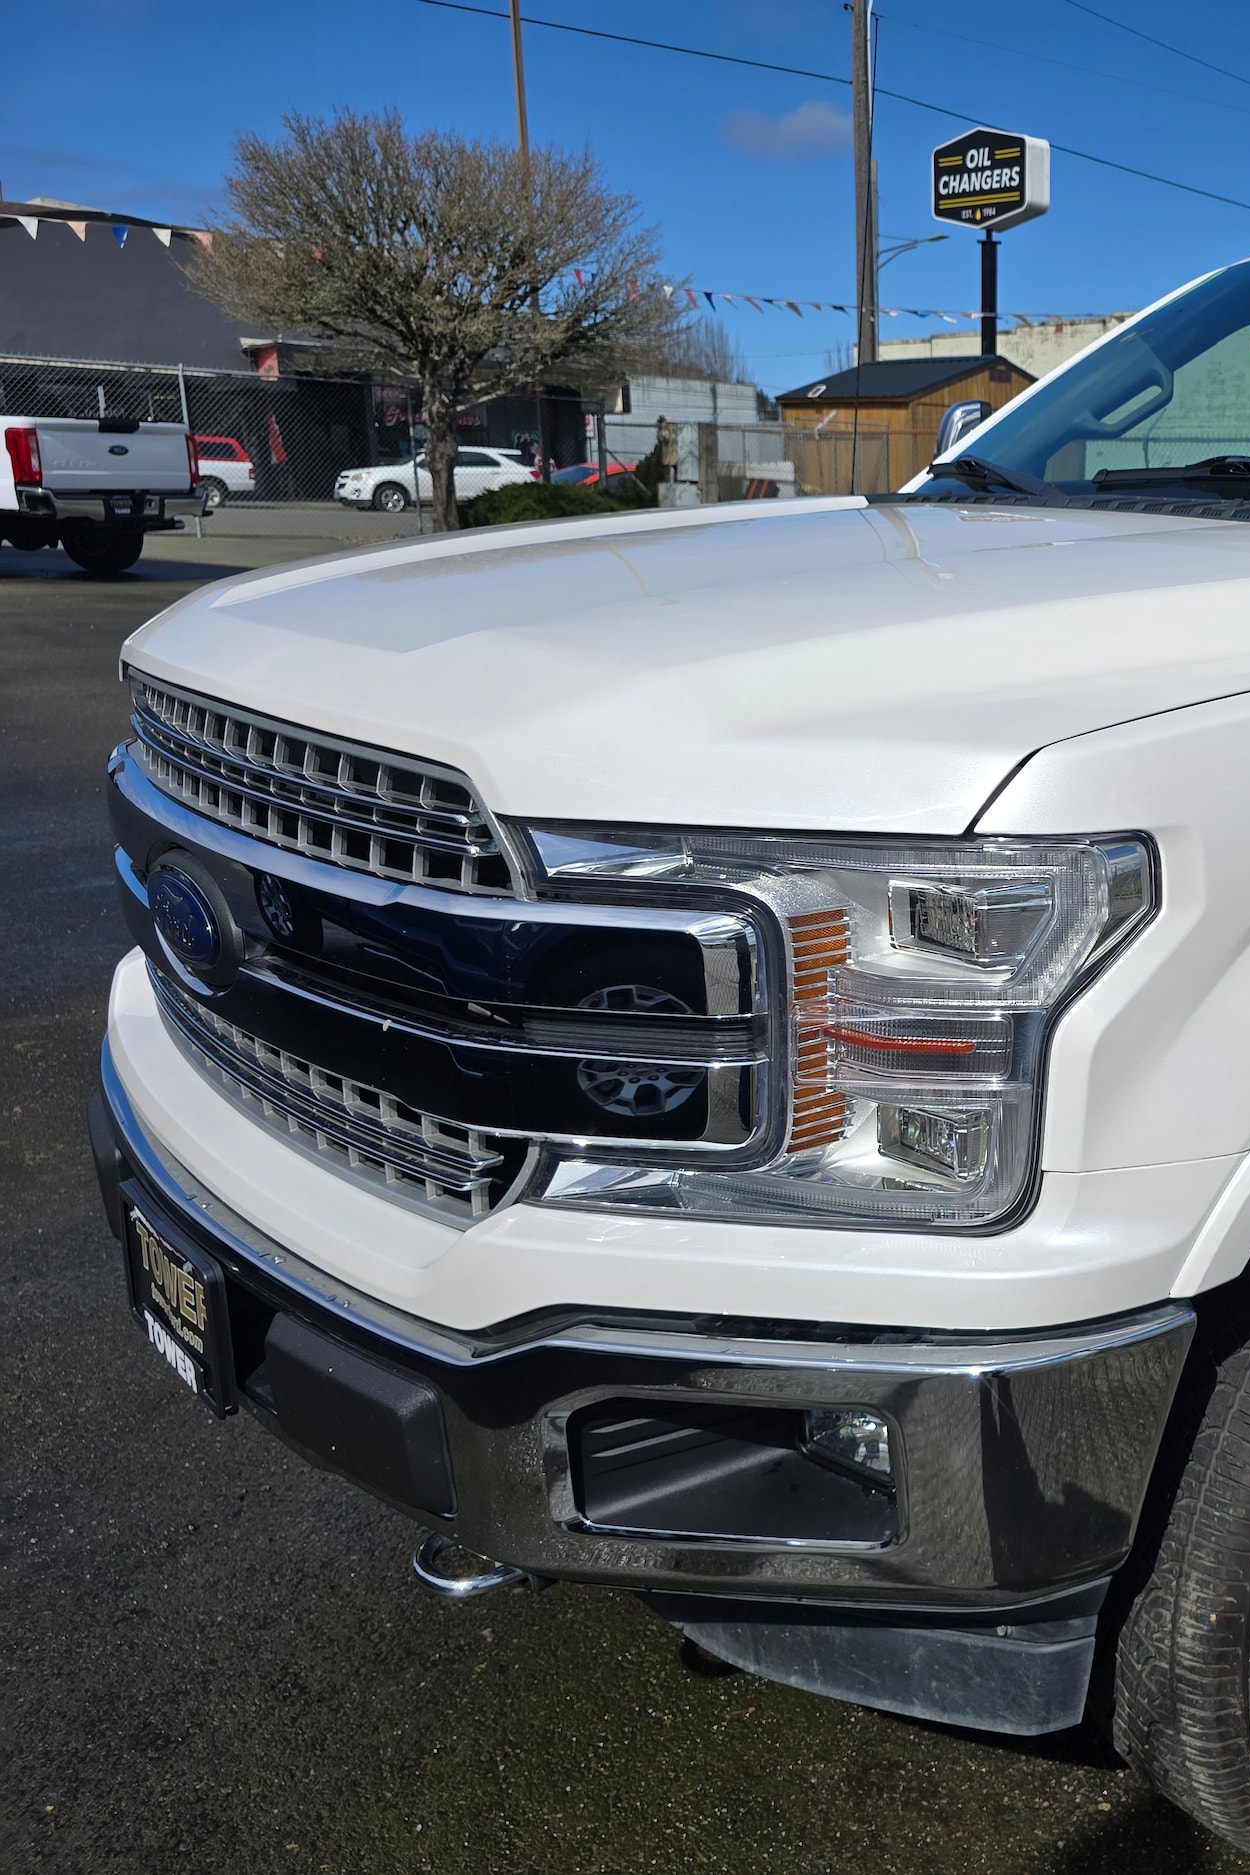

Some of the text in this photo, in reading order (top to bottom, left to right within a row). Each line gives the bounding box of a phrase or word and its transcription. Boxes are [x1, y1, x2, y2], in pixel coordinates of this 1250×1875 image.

[966, 147, 992, 169] OIL
[939, 166, 1021, 195] CHANGERS
[144, 1309, 198, 1395] TOWER
